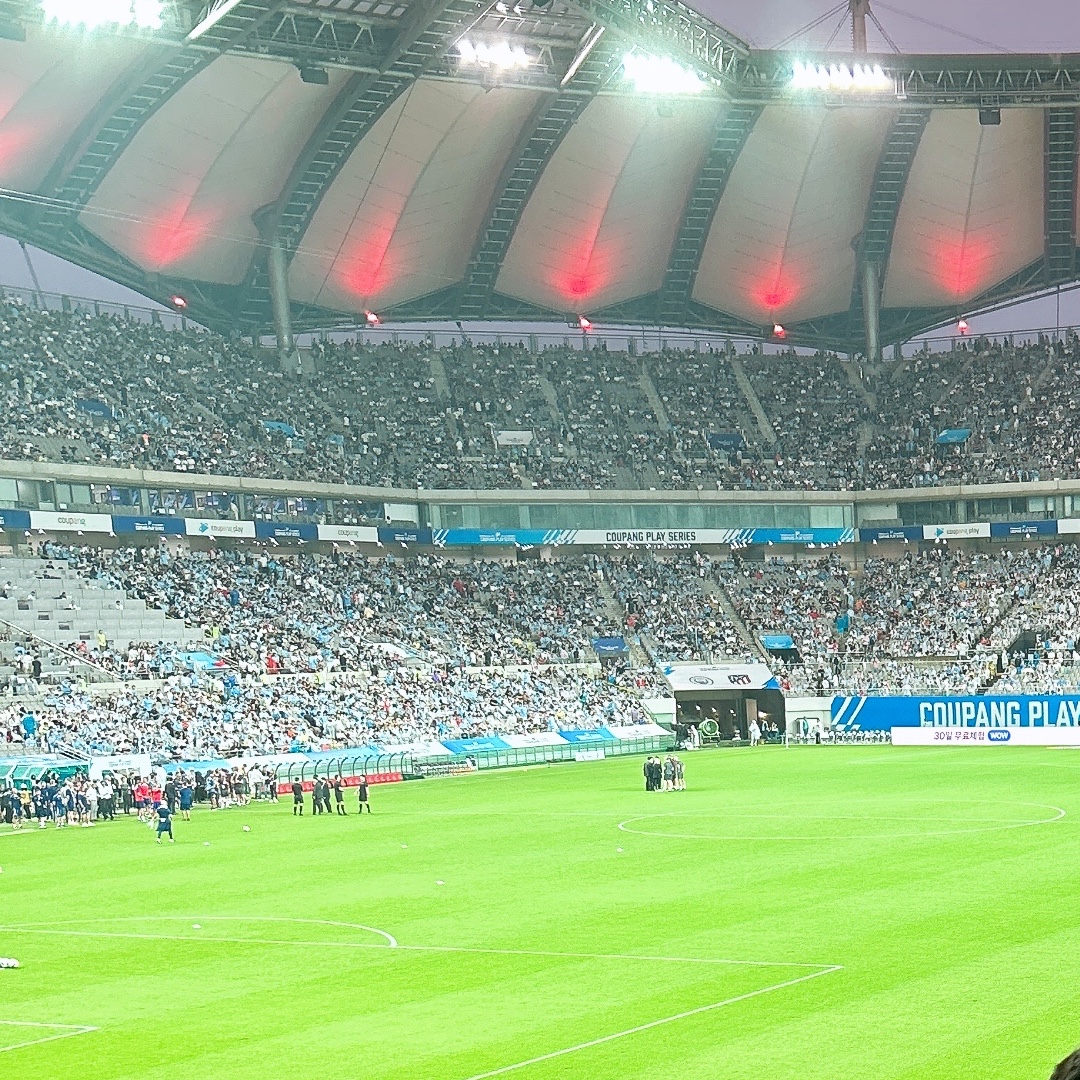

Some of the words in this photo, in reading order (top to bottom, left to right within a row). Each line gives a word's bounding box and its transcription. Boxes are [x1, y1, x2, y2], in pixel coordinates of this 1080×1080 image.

[606, 532, 644, 542] COUPANG
[646, 531, 666, 541] PLAY
[668, 531, 697, 541] SERIES
[919, 701, 1020, 727] COUPANG
[989, 731, 1010, 740] WOW
